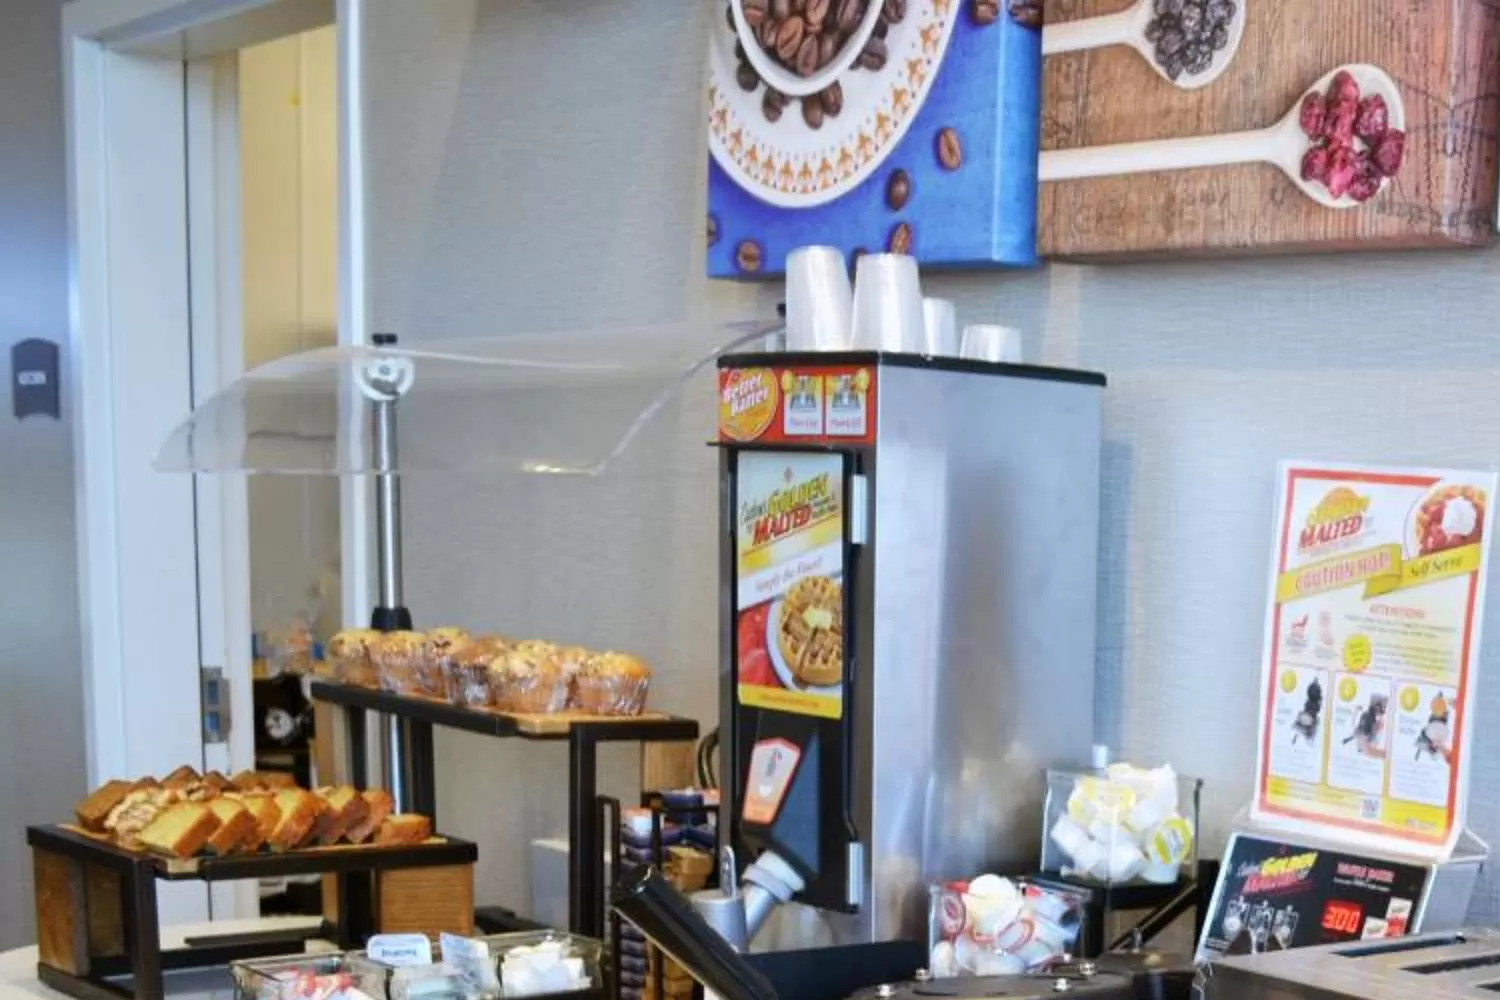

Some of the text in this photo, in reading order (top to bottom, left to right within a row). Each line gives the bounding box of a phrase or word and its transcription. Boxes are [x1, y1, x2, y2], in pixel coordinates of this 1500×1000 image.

[767, 472, 829, 515] GOLDEN
[752, 503, 811, 546] MALTED
[1298, 513, 1363, 549] MALTED
[1321, 904, 1361, 934] 300
